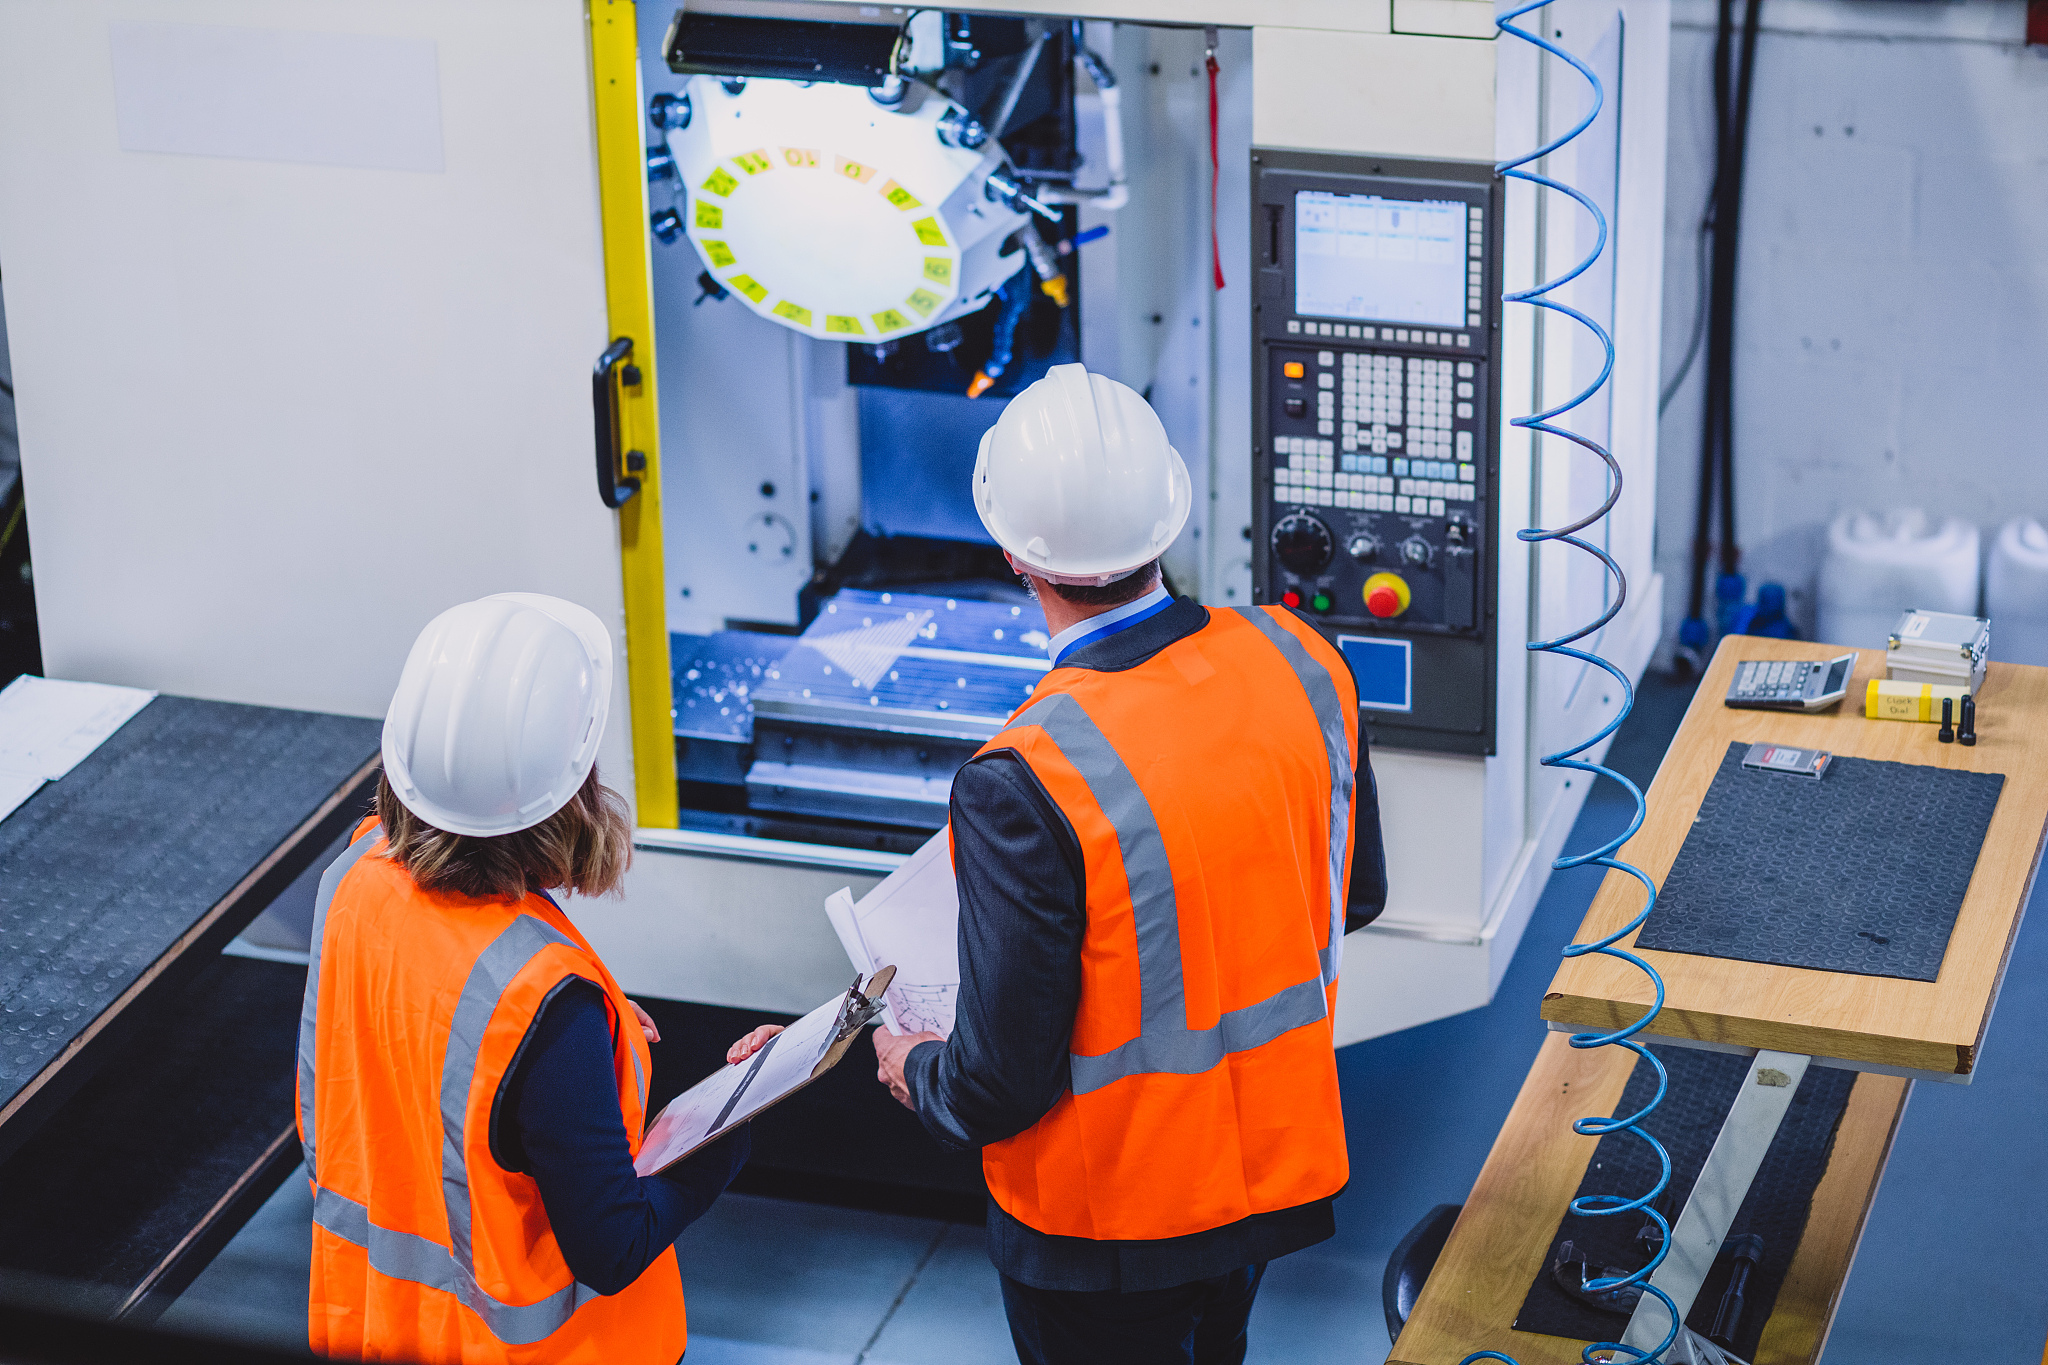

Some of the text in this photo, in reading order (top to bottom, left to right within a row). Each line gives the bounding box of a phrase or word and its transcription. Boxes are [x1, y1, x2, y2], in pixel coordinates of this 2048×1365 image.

[705, 172, 735, 196] 12
[926, 262, 949, 278] 6
[911, 293, 933, 309] 5
